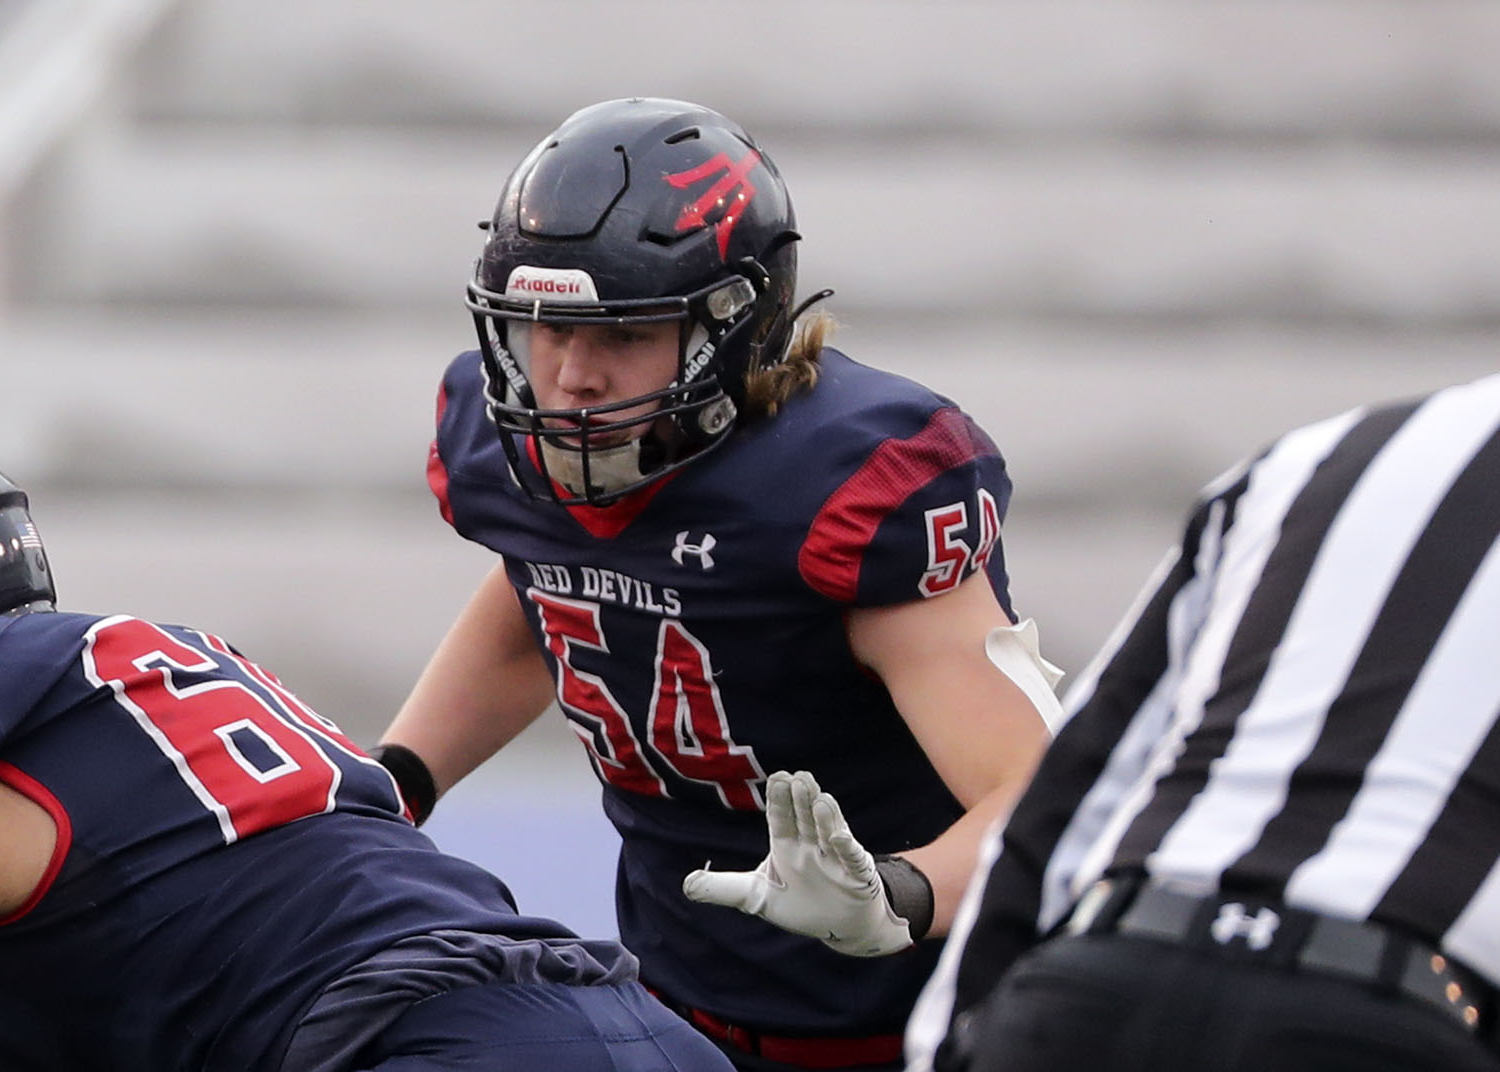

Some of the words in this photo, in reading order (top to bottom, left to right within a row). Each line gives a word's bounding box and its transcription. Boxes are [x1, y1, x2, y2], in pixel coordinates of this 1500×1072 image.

[511, 277, 581, 293] Riddell
[918, 488, 1001, 598] 54
[525, 561, 572, 593] RED
[580, 566, 682, 617] DEVILS
[526, 587, 768, 812] 54
